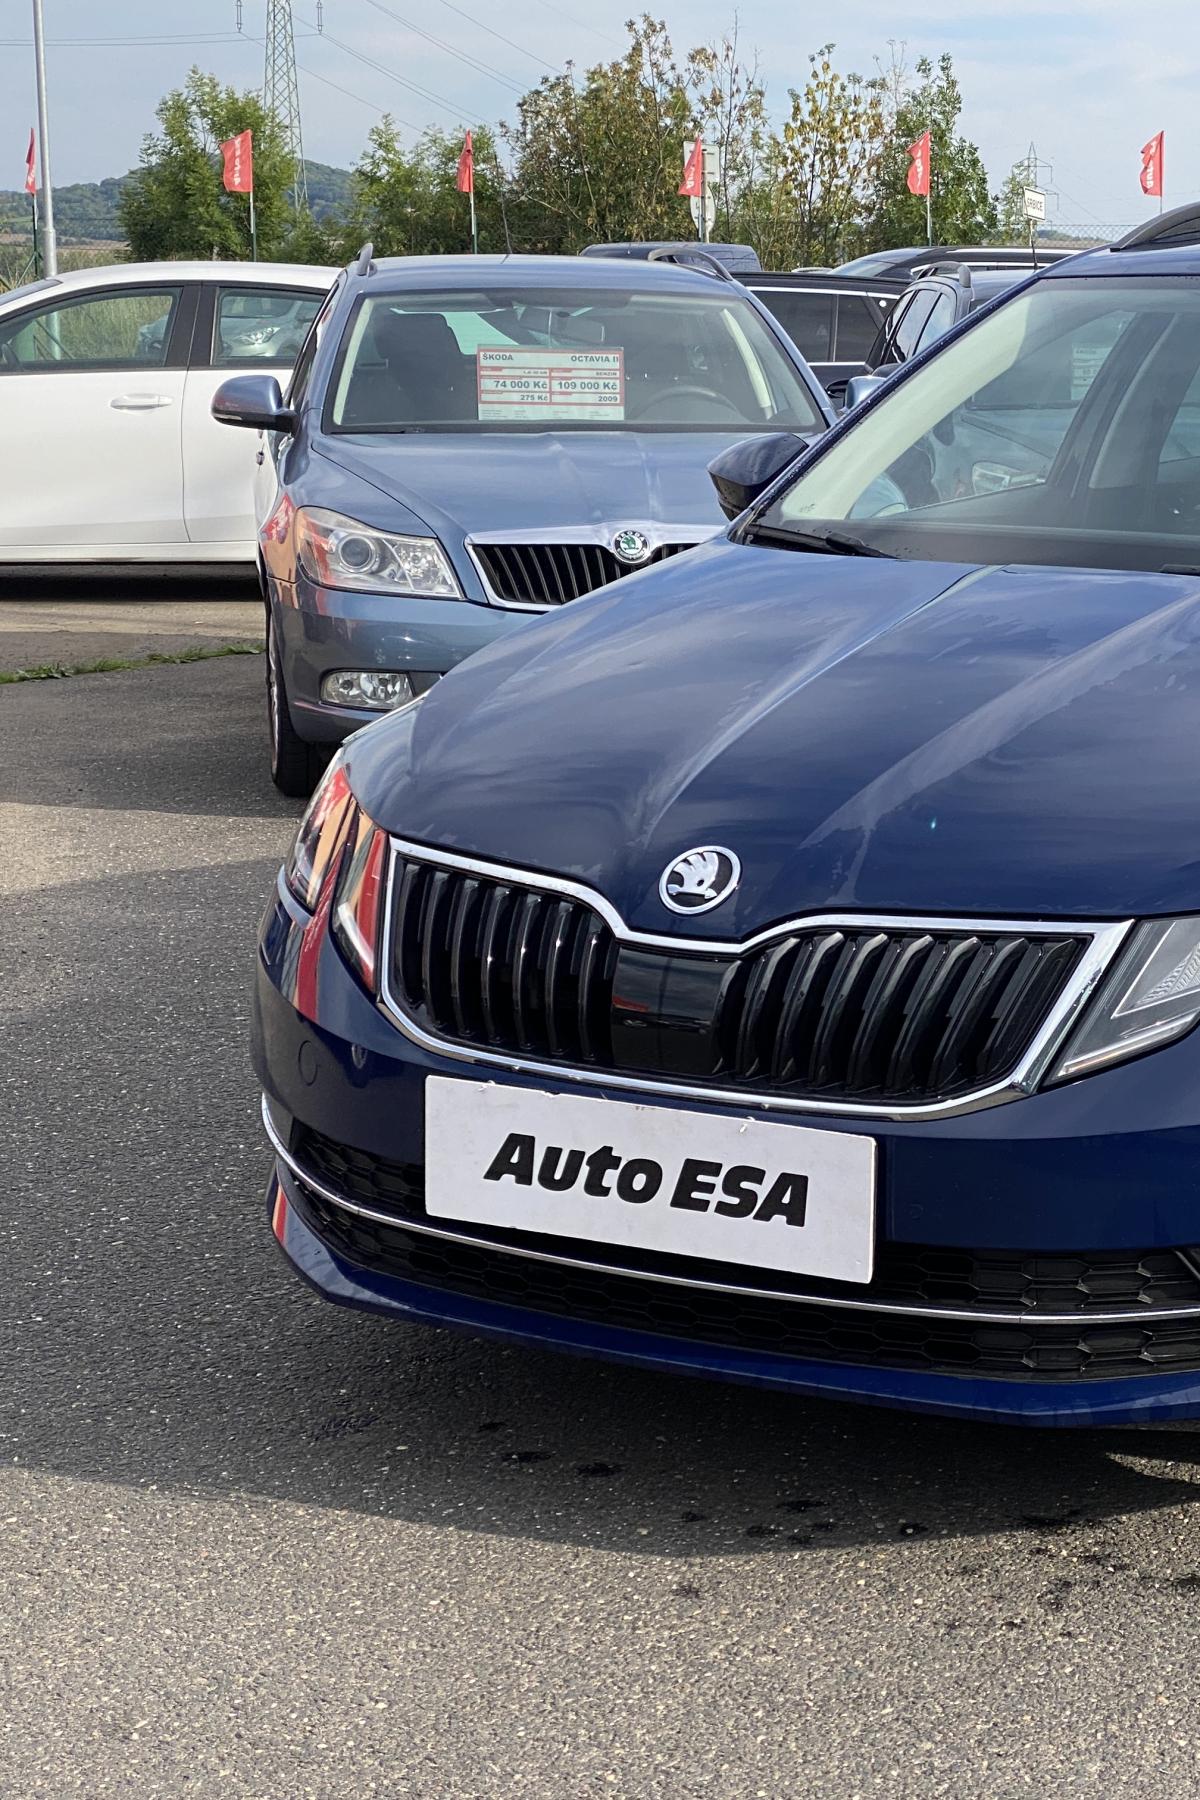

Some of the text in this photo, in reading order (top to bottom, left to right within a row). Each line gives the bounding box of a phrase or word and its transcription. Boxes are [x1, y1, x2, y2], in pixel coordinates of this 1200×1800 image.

[482, 352, 514, 361] ŠKODA
[570, 355, 610, 363] OCTAVIA
[493, 380, 548, 389] 74 000 Kč
[557, 381, 618, 390] 109 000 Kč
[537, 393, 549, 402] Kč
[483, 1132, 809, 1228] Auto ESA
